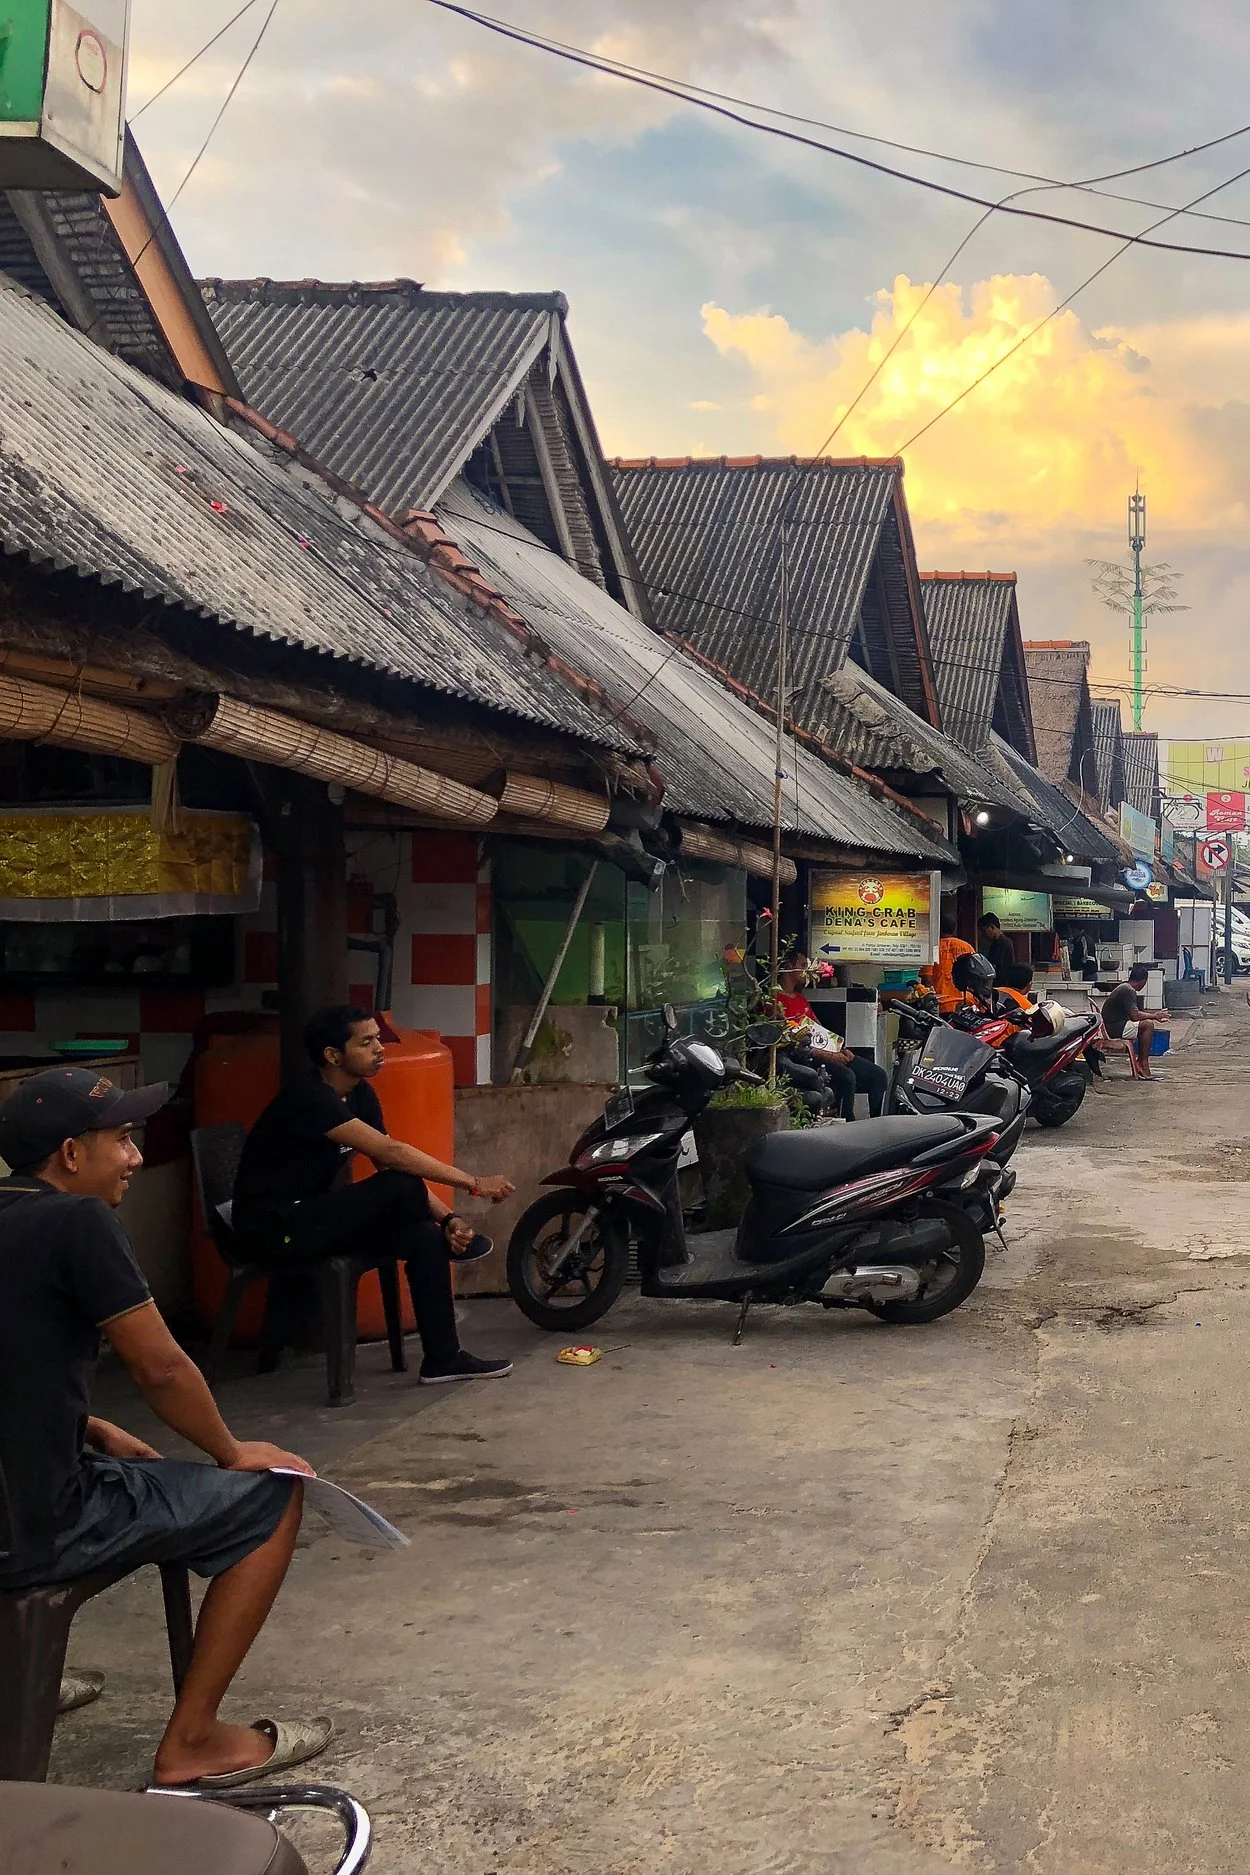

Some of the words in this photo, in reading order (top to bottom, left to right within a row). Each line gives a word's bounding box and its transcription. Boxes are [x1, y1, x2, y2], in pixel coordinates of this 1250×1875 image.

[1209, 808, 1243, 817] Roman
[825, 906, 866, 917] KING
[872, 907, 916, 919] CRAB
[825, 917, 875, 928] DENA'S
[880, 919, 916, 929] CAFE
